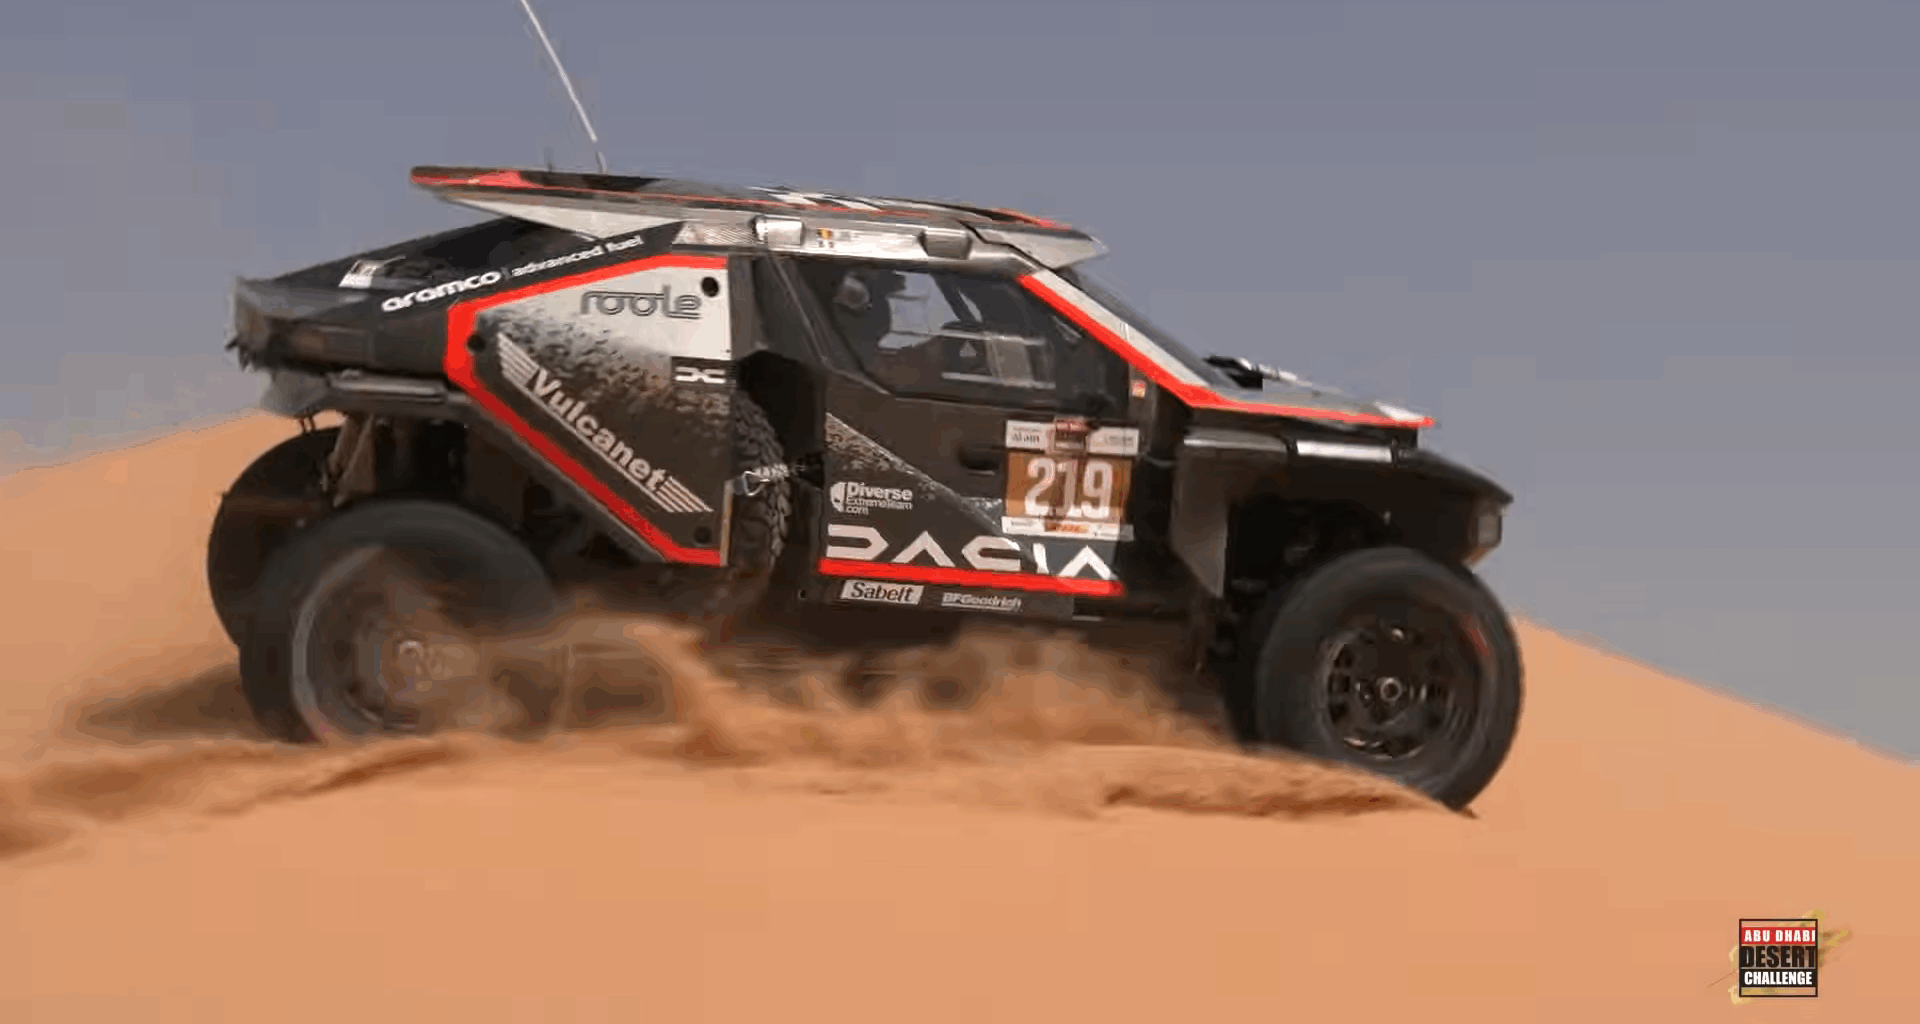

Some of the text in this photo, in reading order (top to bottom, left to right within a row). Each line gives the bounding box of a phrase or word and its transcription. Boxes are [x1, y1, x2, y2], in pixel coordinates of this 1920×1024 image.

[381, 235, 645, 312] aramco advanced fuel
[580, 284, 703, 319] roole
[532, 368, 668, 493] Vulcanet
[847, 482, 914, 501] Diverse
[1024, 457, 1113, 519] 219
[826, 524, 1114, 580] DACIA
[850, 582, 914, 602] Sabelt
[942, 592, 1022, 608] BFGoodrich
